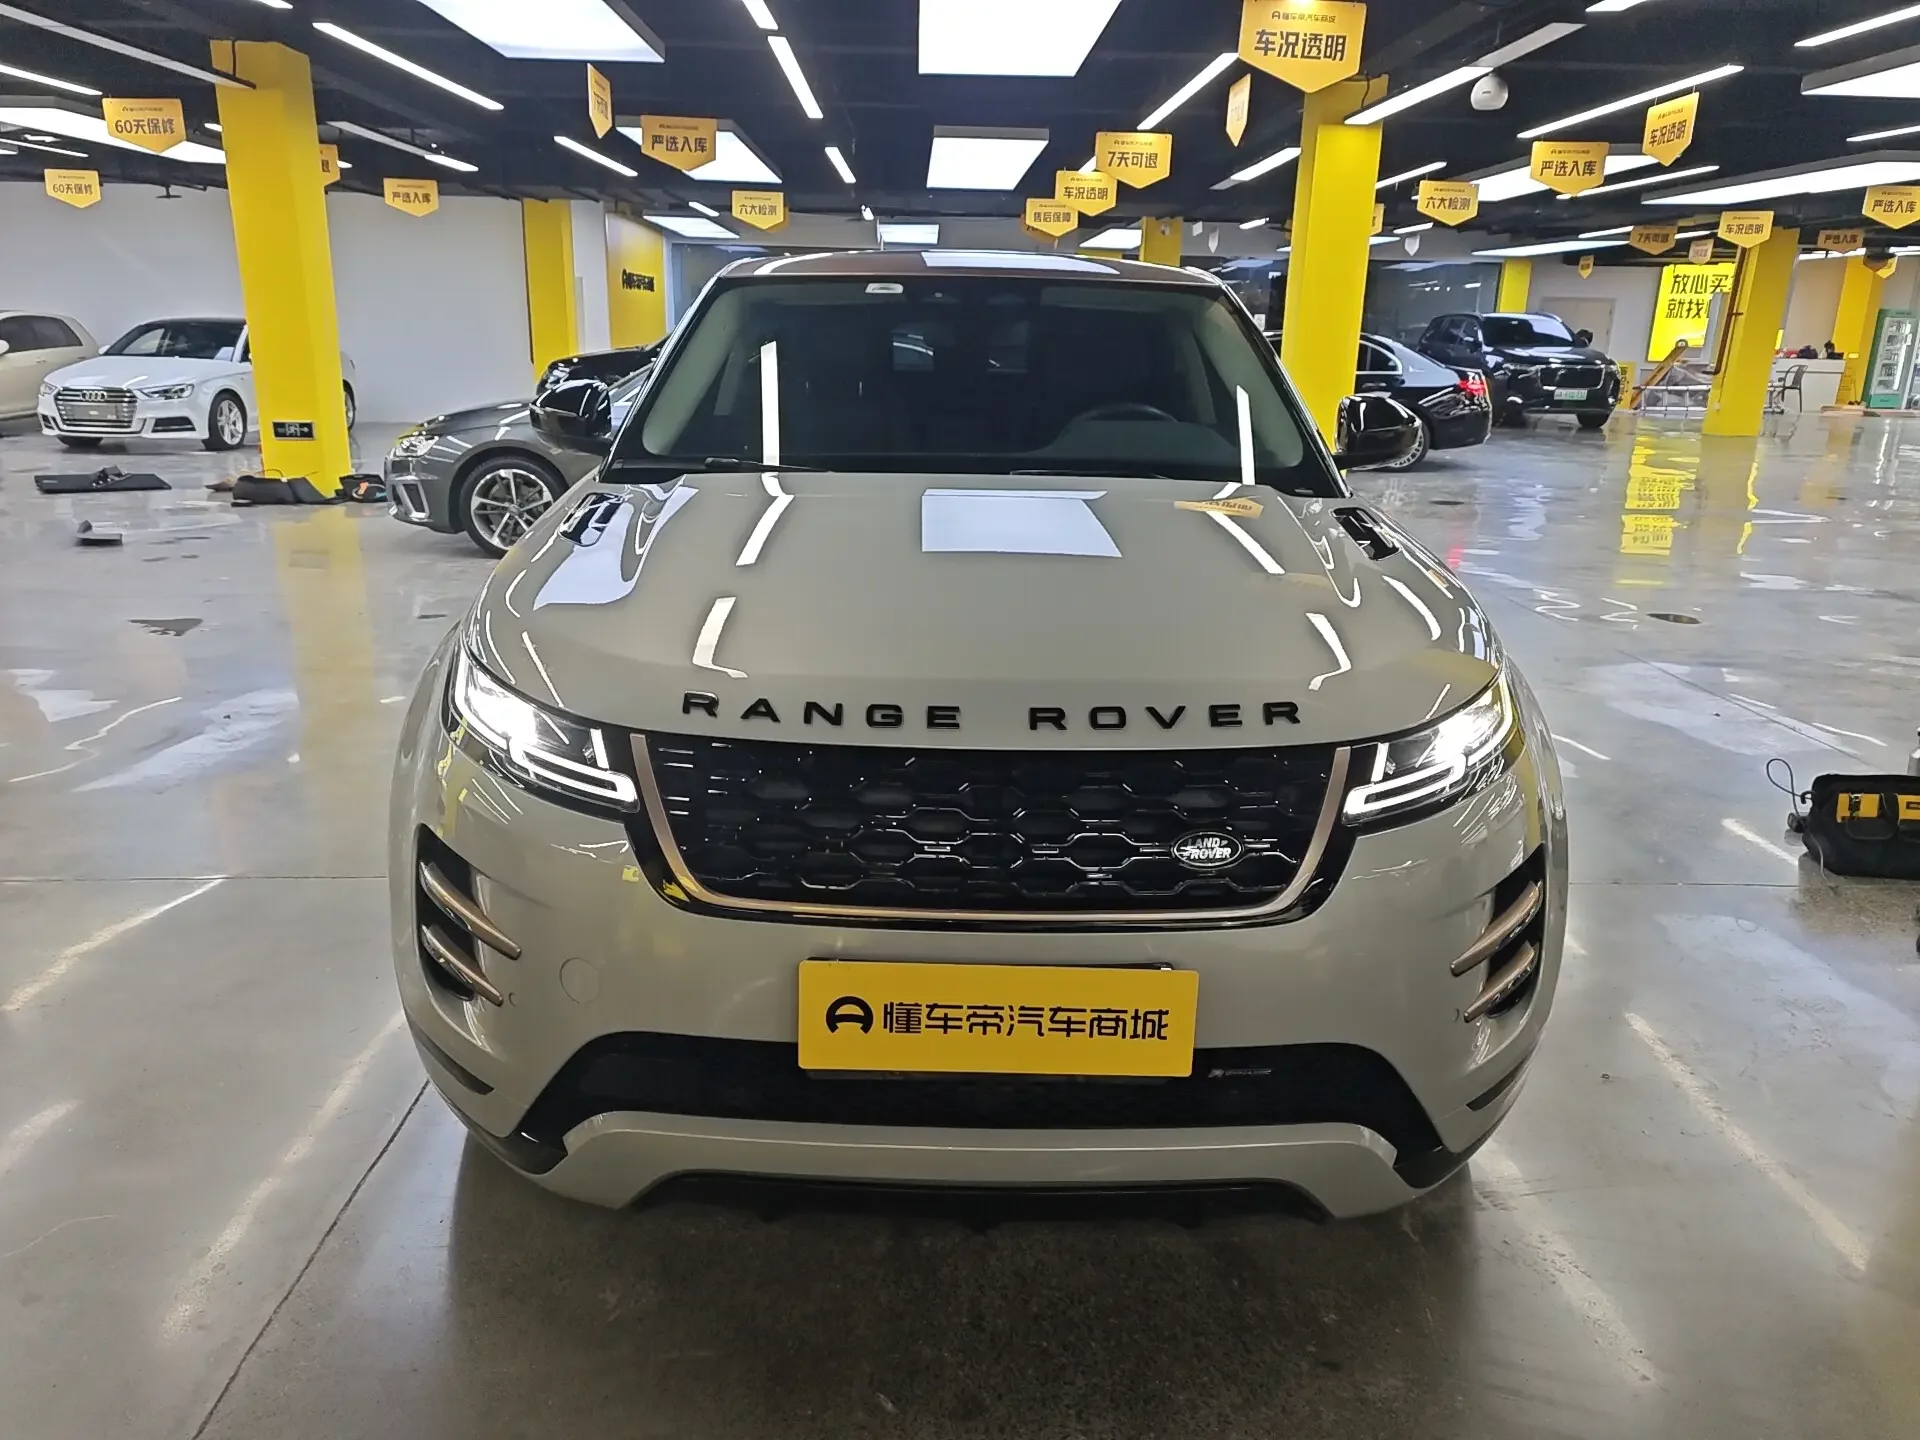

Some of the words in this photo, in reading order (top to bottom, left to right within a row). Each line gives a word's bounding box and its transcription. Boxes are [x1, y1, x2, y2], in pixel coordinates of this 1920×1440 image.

[1254, 29, 1347, 61] 车况透明
[115, 118, 175, 135] 60天保修
[1649, 119, 1687, 147] 车况透明
[651, 135, 707, 153] 严选入库
[1107, 151, 1158, 169] 7天可退
[1540, 160, 1597, 177] 严选入库
[1063, 186, 1108, 201] 车况透明
[738, 204, 777, 216] 六大检测
[1425, 197, 1471, 210] 六大检测
[1871, 199, 1917, 213] 严选入库
[1033, 211, 1071, 223] 售后保障
[1724, 223, 1764, 235] 车况透明
[1670, 273, 1734, 295] 放心买
[682, 690, 960, 730] RANGE
[1028, 702, 1301, 731] ROVER
[1187, 837, 1221, 849] LAND
[1190, 847, 1232, 860] ROVER
[883, 1001, 1170, 1041] 懂车帝汽车商城
